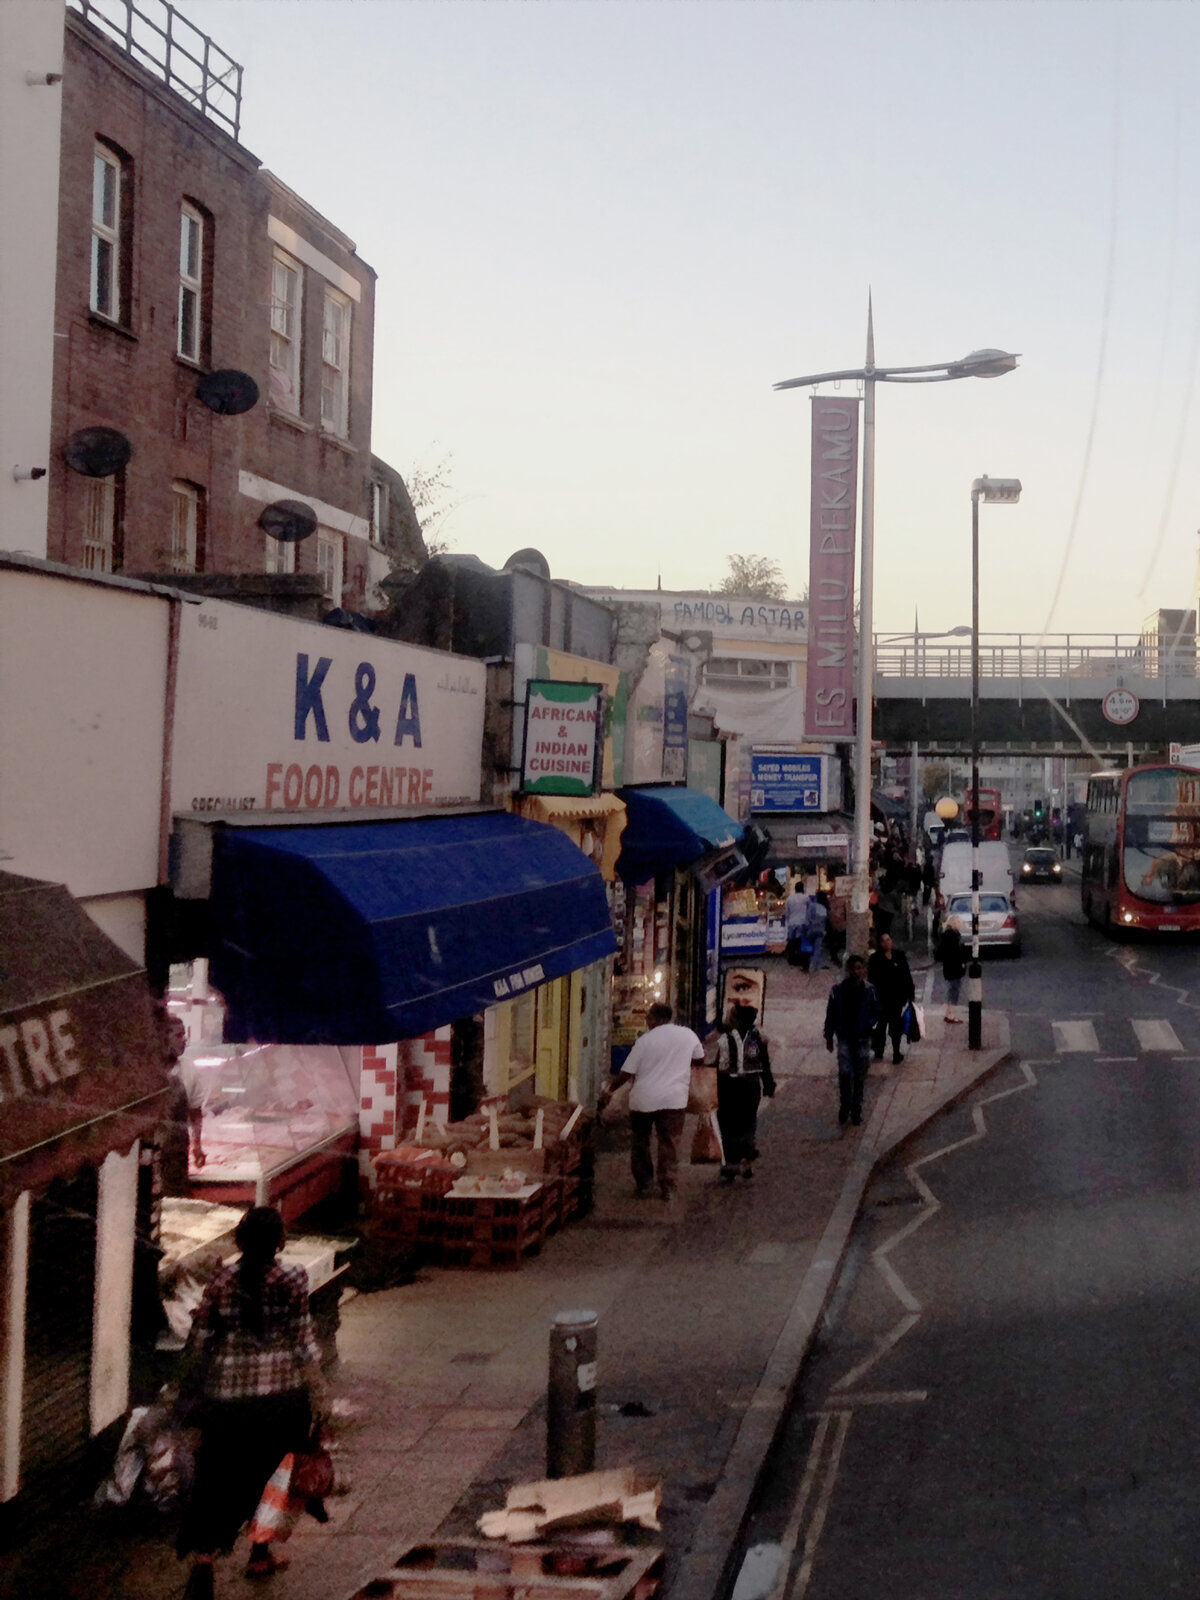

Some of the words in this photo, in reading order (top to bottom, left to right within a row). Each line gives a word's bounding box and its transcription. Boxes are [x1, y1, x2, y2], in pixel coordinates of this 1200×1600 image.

[294, 652, 333, 743] K
[348, 661, 381, 744] &
[394, 672, 422, 748] A
[531, 706, 597, 722] AFRICAN
[557, 725, 568, 738] &
[535, 741, 588, 756] INDIAN
[529, 758, 591, 773] CUISINE
[758, 773, 782, 781] MONEY
[265, 763, 340, 809] FOOD
[348, 766, 434, 807] CENTRE
